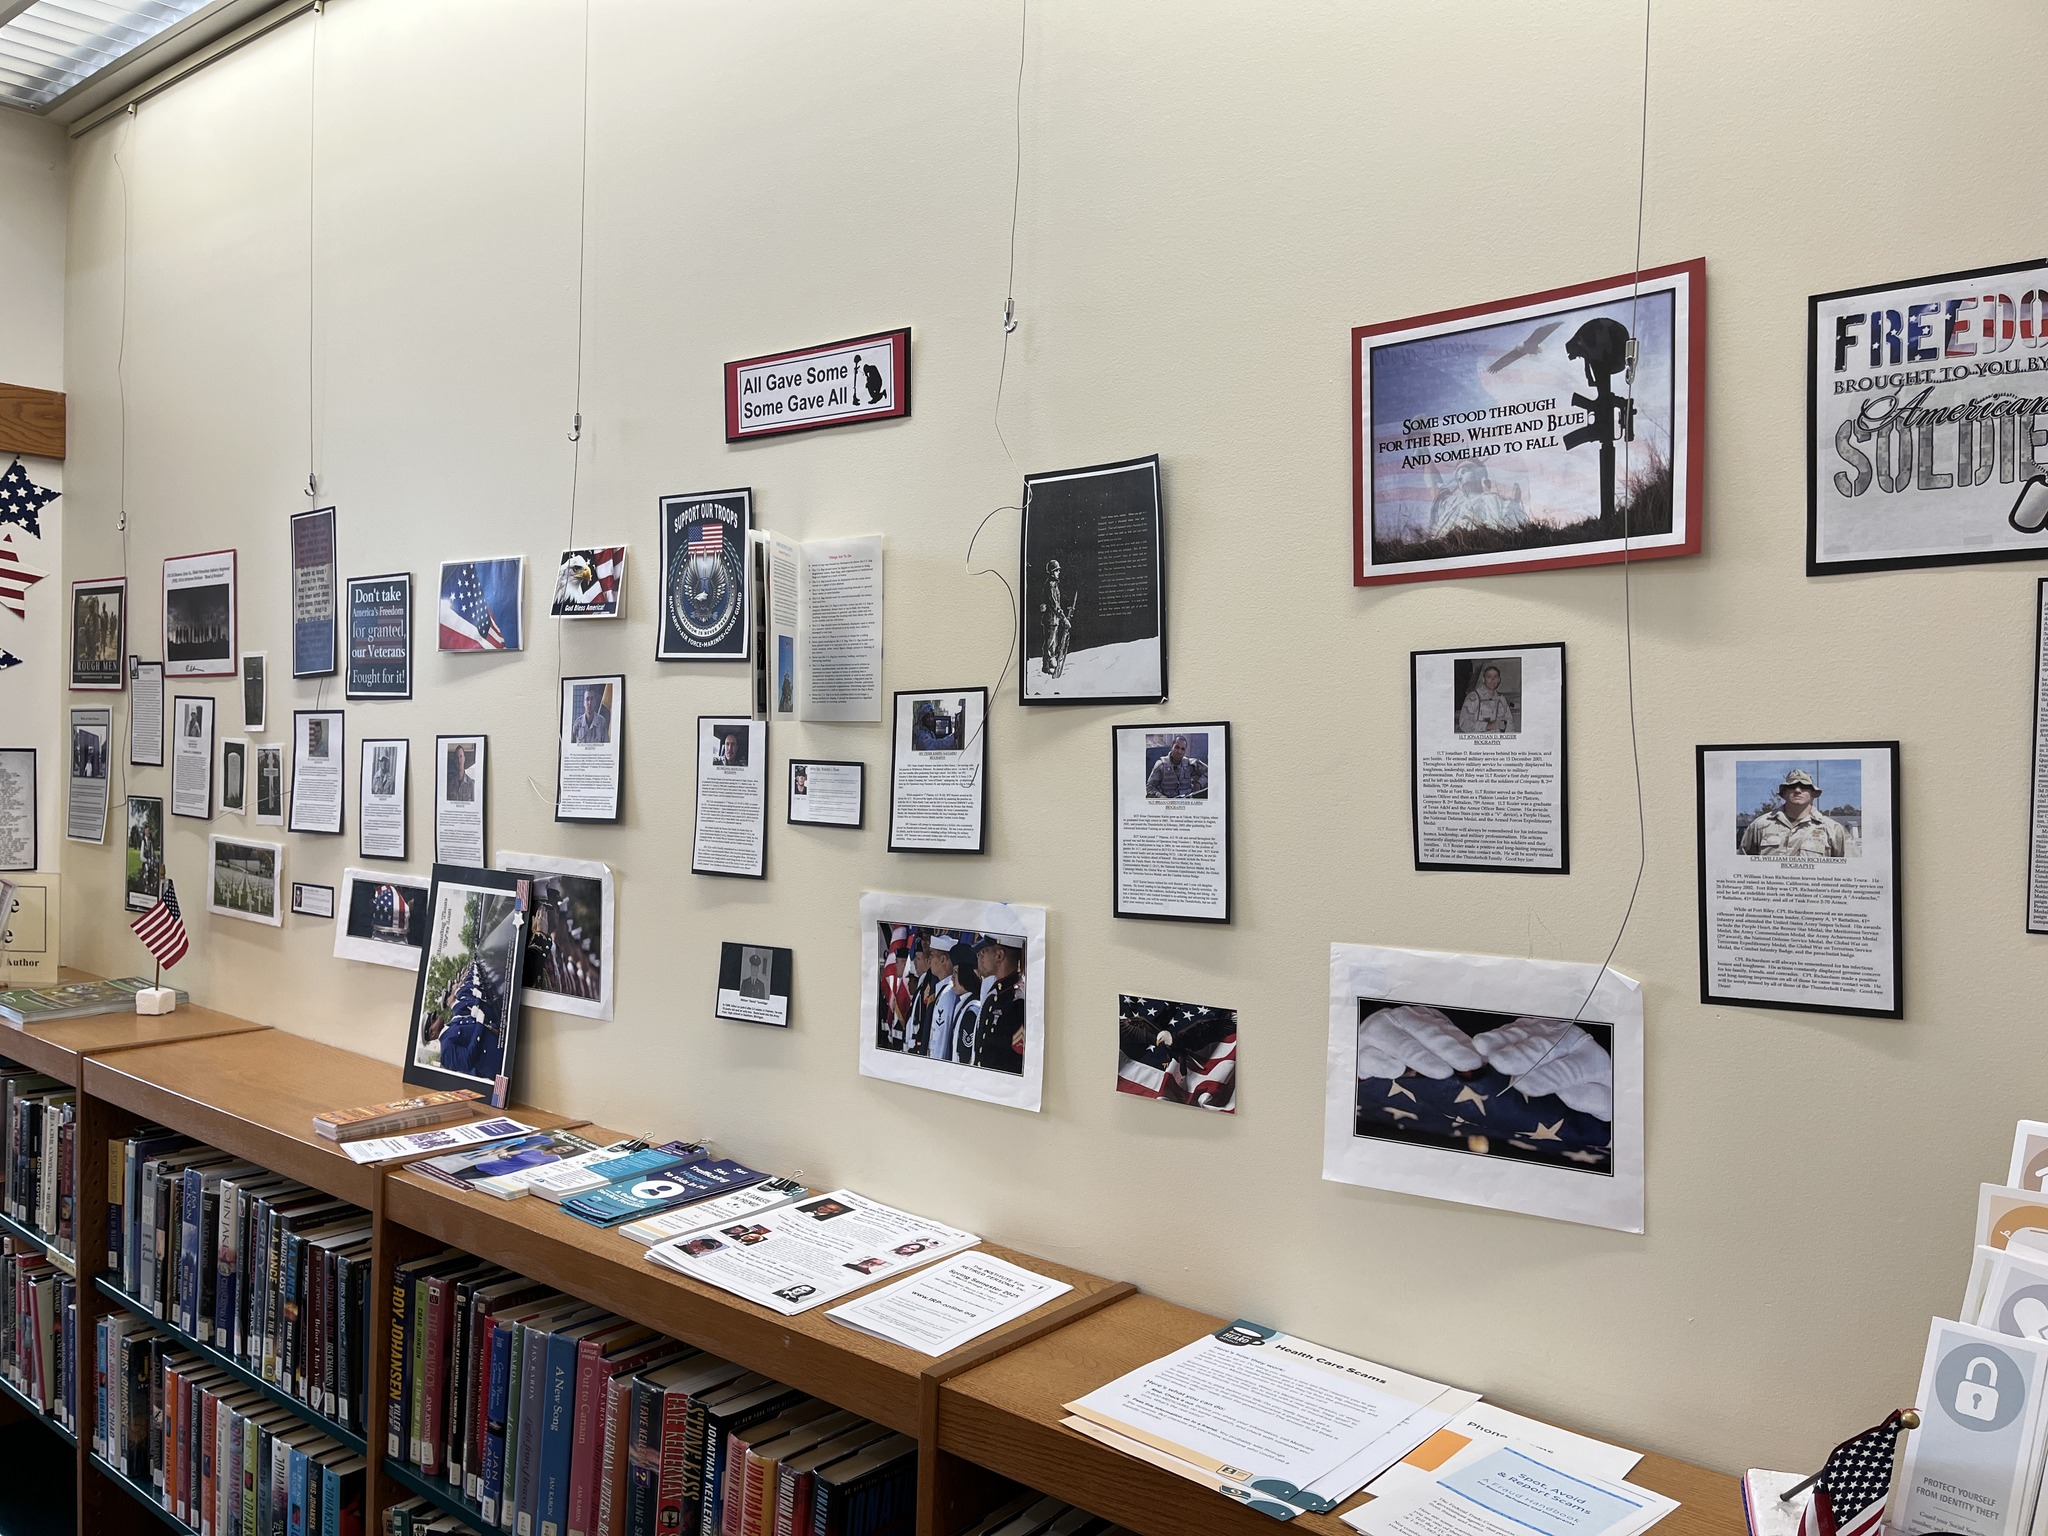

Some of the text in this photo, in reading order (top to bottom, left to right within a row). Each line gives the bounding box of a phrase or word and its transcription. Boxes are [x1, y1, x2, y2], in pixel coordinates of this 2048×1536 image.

[1834, 289, 2048, 372] FREEDO
[743, 365, 848, 396] All Gave Some
[1833, 368, 1937, 395] BROUGHT
[1942, 364, 1969, 381] TO
[1975, 359, 2020, 378] YOU
[744, 386, 847, 419] Some Gave All
[1402, 398, 1556, 435] SOME STOOD THROUGH
[1379, 412, 1585, 453] FOR THE RED, WHITE AND BLUE
[1401, 435, 1559, 469] AND SOME HAD TO FALL
[1833, 412, 2048, 498] SOLDIE
[674, 503, 739, 534] SUPPORT OUR TROOPS
[352, 605, 404, 617] America's Freedom
[355, 586, 402, 603] Don't take
[574, 604, 586, 612] Bless
[352, 619, 407, 642] for granted,
[672, 615, 681, 632] ARMY
[680, 631, 688, 643] AIR
[687, 637, 702, 649] FORCE
[703, 634, 725, 648] MARINES
[725, 615, 737, 635] COAST
[734, 591, 743, 615] GUARD
[77, 660, 117, 672] ROUGH MEN
[351, 644, 406, 658] our Veterans
[352, 669, 405, 687] Fought for it!
[6, 958, 40, 967] Author
[672, 1176, 688, 1184] Kids
[680, 1170, 716, 1186] Happens
[689, 1165, 731, 1183] Trafficking
[713, 1168, 730, 1176] Sex
[222, 1184, 232, 1219] JOHN
[596, 1189, 620, 1200] Service
[258, 1219, 267, 1275] GREY
[269, 1247, 278, 1284] JANCE
[286, 1263, 297, 1300] JANCE
[960, 1264, 987, 1277] RETIRED
[948, 1269, 1020, 1299] Spring Semester 2025
[388, 1285, 405, 1401] ROY JOHANSEN
[580, 1347, 598, 1355] LARGE
[1221, 1331, 1250, 1344] HEARD
[424, 1338, 437, 1392] COWBOY
[1214, 1345, 1266, 1367] Here's how they
[1274, 1344, 1387, 1385] Health Care Scams
[120, 1348, 130, 1426] IRIS JOHANSEN
[528, 1364, 536, 1401] KARON
[550, 1366, 565, 1432] A New Song
[582, 1366, 593, 1402] Out to
[1145, 1379, 1213, 1408] Here's what you can
[392, 1403, 402, 1433] KILLER
[599, 1391, 607, 1429] KARON
[640, 1406, 651, 1426] FAYE
[603, 1387, 619, 1473] FAYE KELLERMAN
[484, 1437, 494, 1489] KARON
[661, 1393, 688, 1502] FAYE KELLERMAN
[705, 1423, 717, 1481] JONATHAN
[491, 1450, 500, 1481] JAN
[681, 1459, 702, 1502] KISS
[309, 1480, 317, 1494] IRIS
[548, 1476, 556, 1491] JAN
[726, 1443, 743, 1535] JONATHAN KELLERMAN
[744, 1459, 765, 1521] JONATHAN
[779, 1473, 796, 1518] JONATHAN
[1497, 1471, 1592, 1516] & Report Scams
[1518, 1472, 1586, 1505] Spot, Avoid
[1923, 1476, 1997, 1507] PROTECT YOURSELF
[814, 1484, 829, 1536] JONATHAN
[1490, 1482, 1581, 1524] Fraud Handbook
[1530, 1504, 1576, 1527] and Immigrants
[1916, 1486, 2000, 1520] FROM IDENTITY THEFT
[1919, 1511, 1965, 1531] Guard your Social
